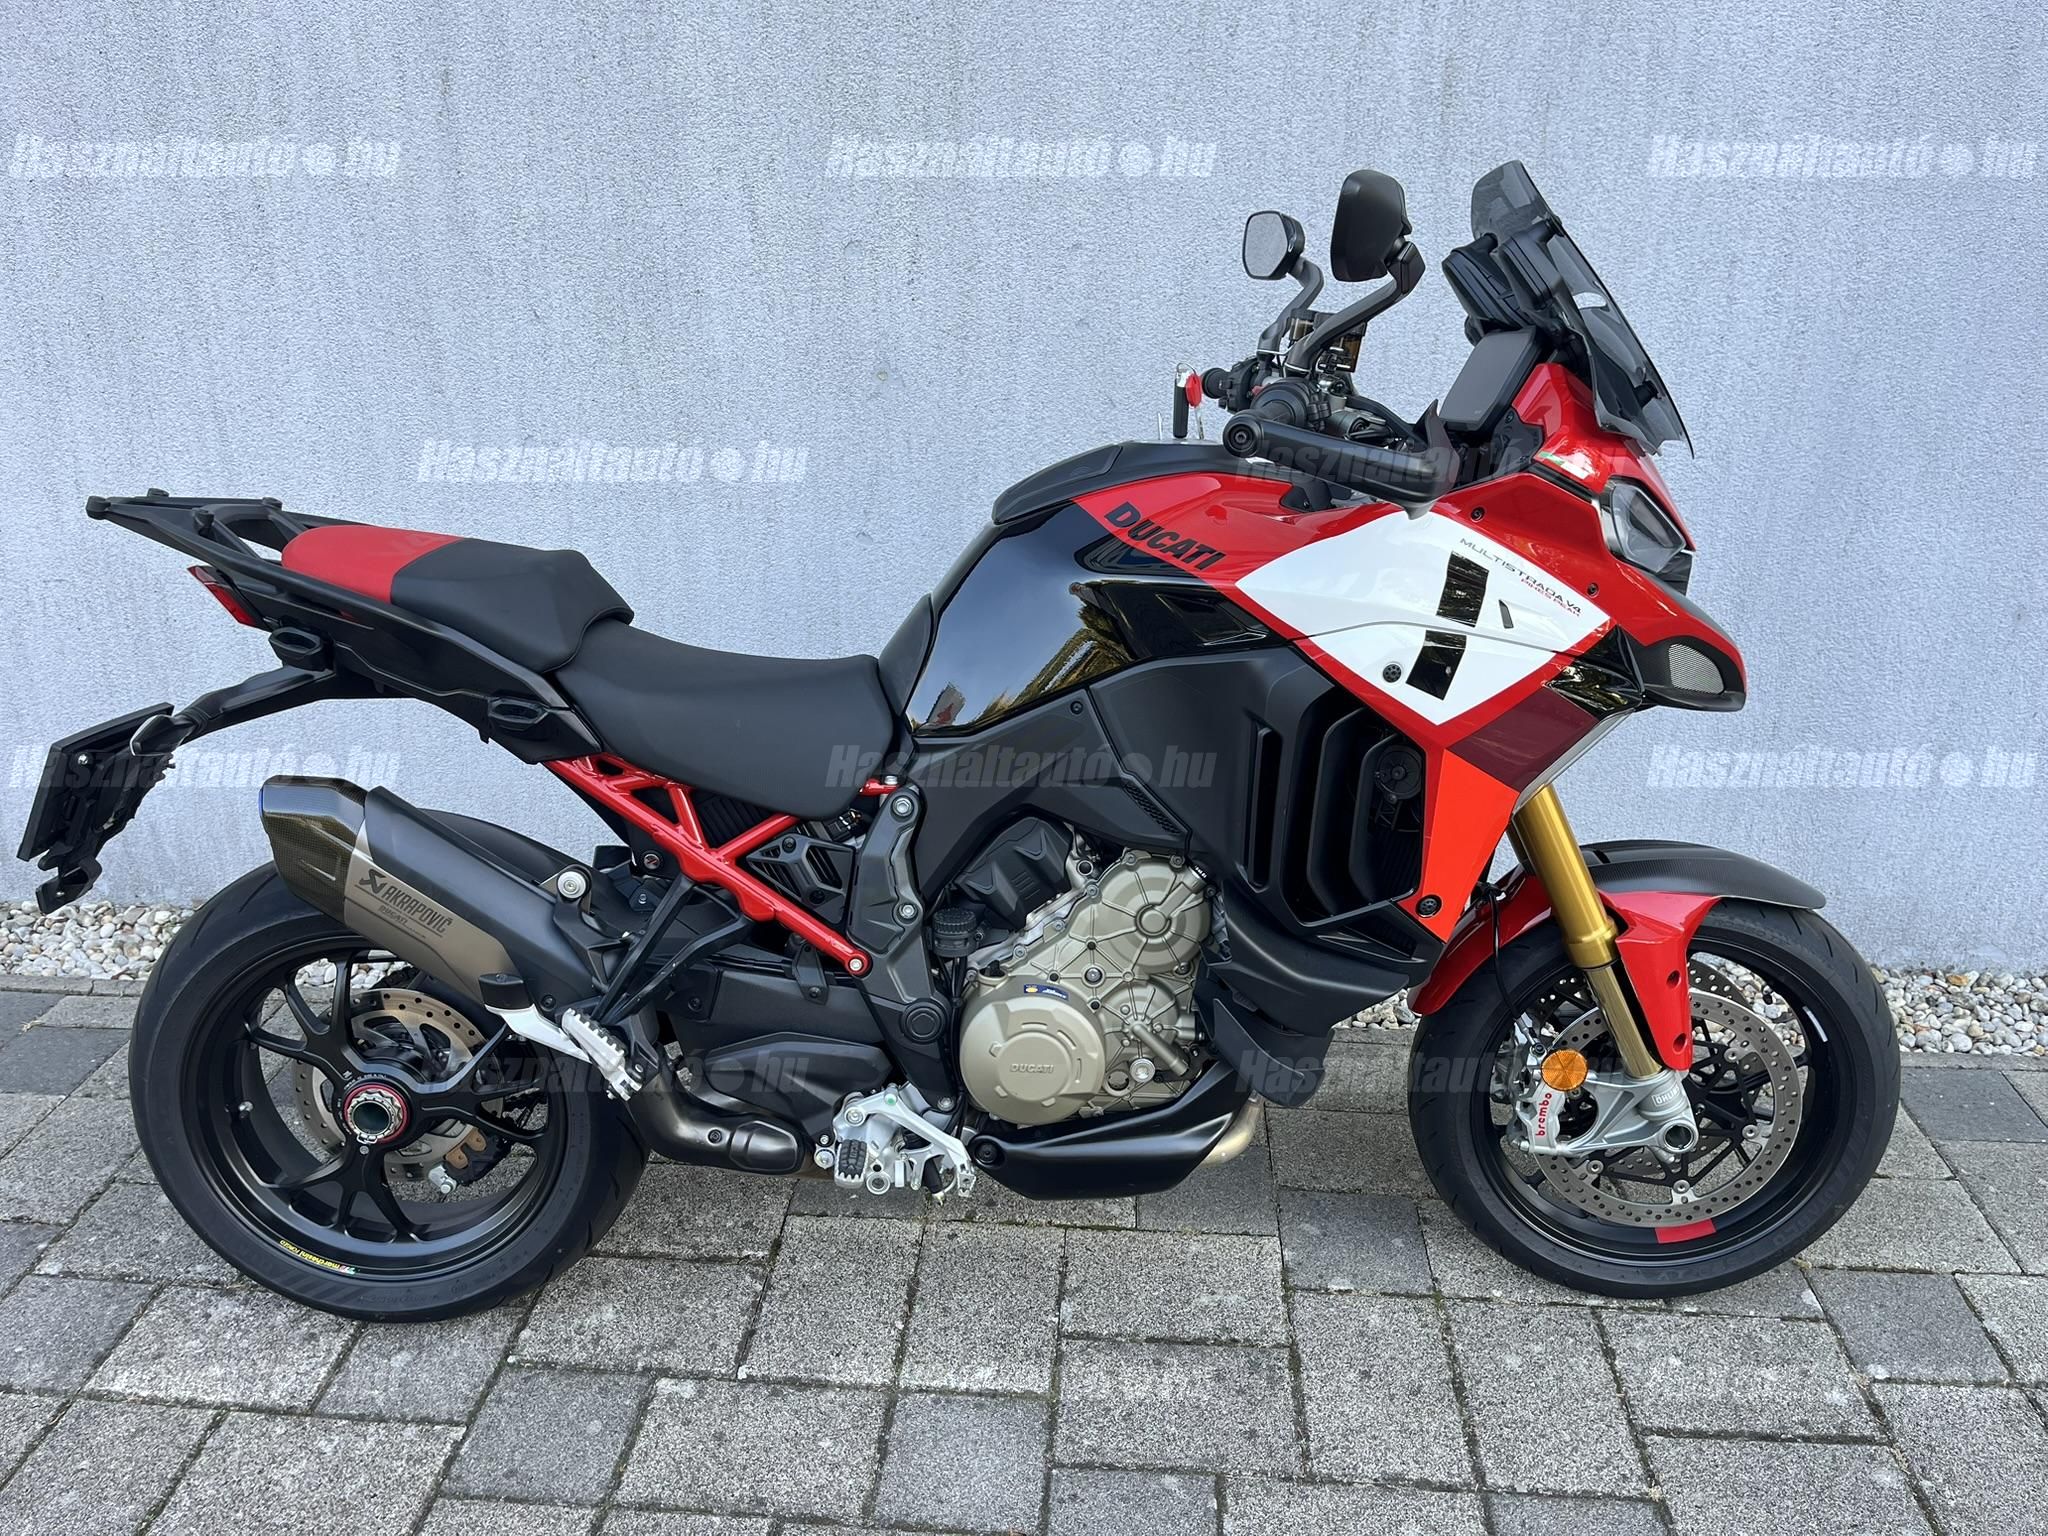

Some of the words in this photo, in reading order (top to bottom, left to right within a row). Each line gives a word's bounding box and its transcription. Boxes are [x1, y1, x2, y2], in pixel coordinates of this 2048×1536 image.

[1104, 501, 1226, 570] DUCATI
[1460, 538, 1564, 602] MULTISTRADA
[1010, 1063, 1054, 1074] DUCATI
[1535, 1092, 1553, 1136] brembo
